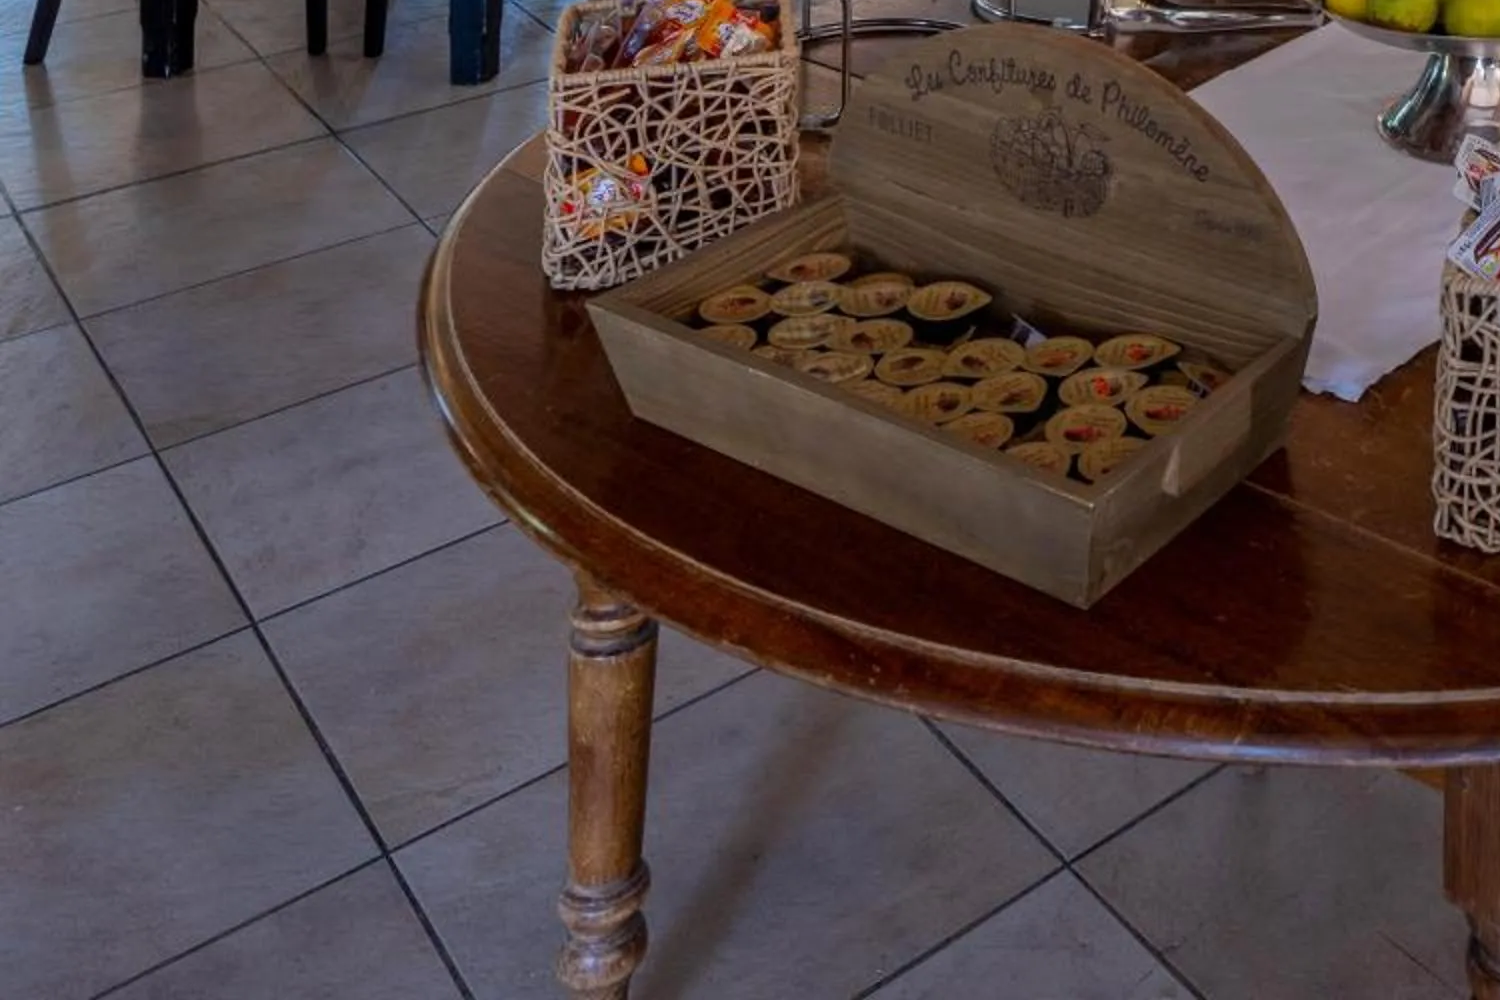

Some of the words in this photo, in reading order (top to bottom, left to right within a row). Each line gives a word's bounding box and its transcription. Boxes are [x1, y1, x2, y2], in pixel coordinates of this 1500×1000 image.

[948, 49, 1057, 94] Confitures
[1065, 71, 1093, 104] de
[1101, 79, 1211, 183] Philomène
